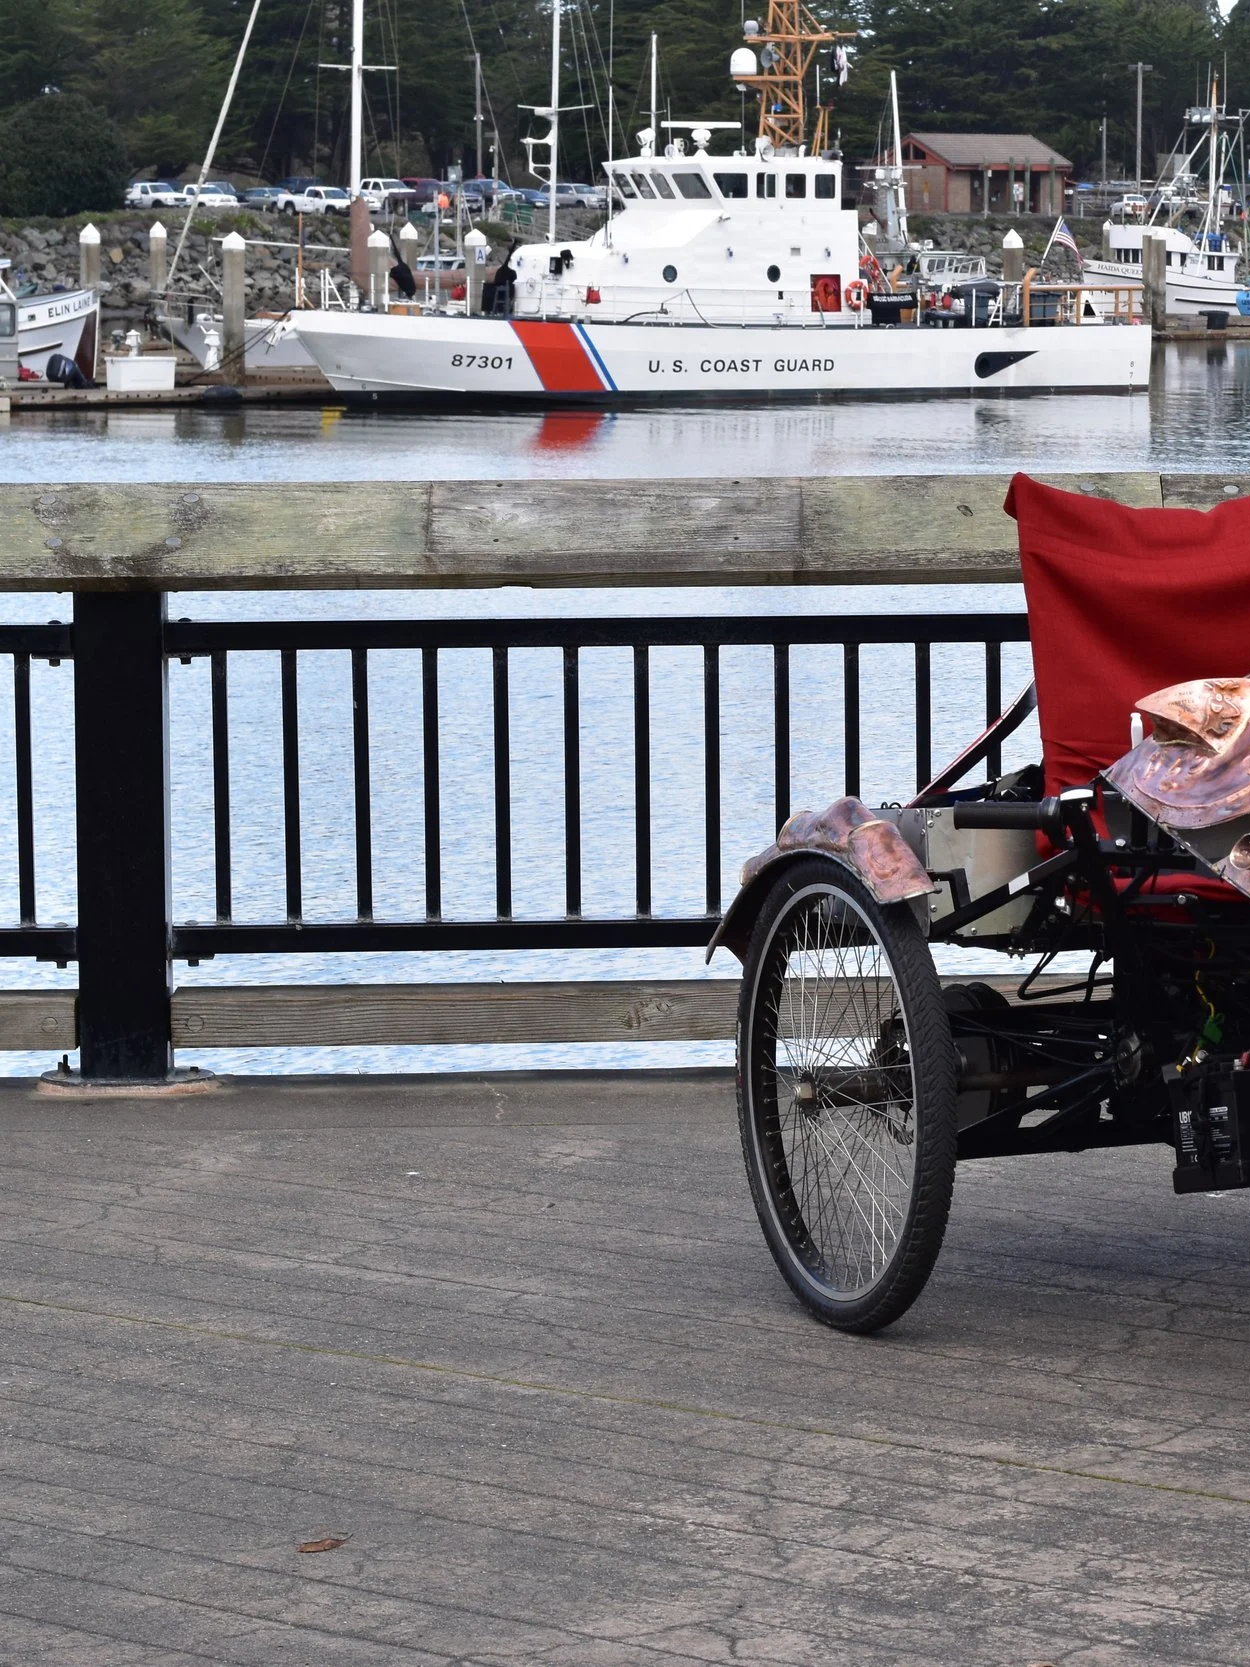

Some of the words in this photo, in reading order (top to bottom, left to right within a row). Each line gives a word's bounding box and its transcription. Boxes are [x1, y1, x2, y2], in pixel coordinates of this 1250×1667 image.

[477, 248, 484, 261] A
[1097, 263, 1120, 273] HAIDA
[1121, 267, 1142, 276] QUEE
[48, 304, 70, 318] ELIN
[451, 354, 513, 370] 87301
[648, 360, 665, 373] U.
[672, 360, 688, 373] S.
[700, 359, 762, 373] COAST
[774, 358, 835, 372] GUARD
[1178, 1110, 1193, 1124] UB1
